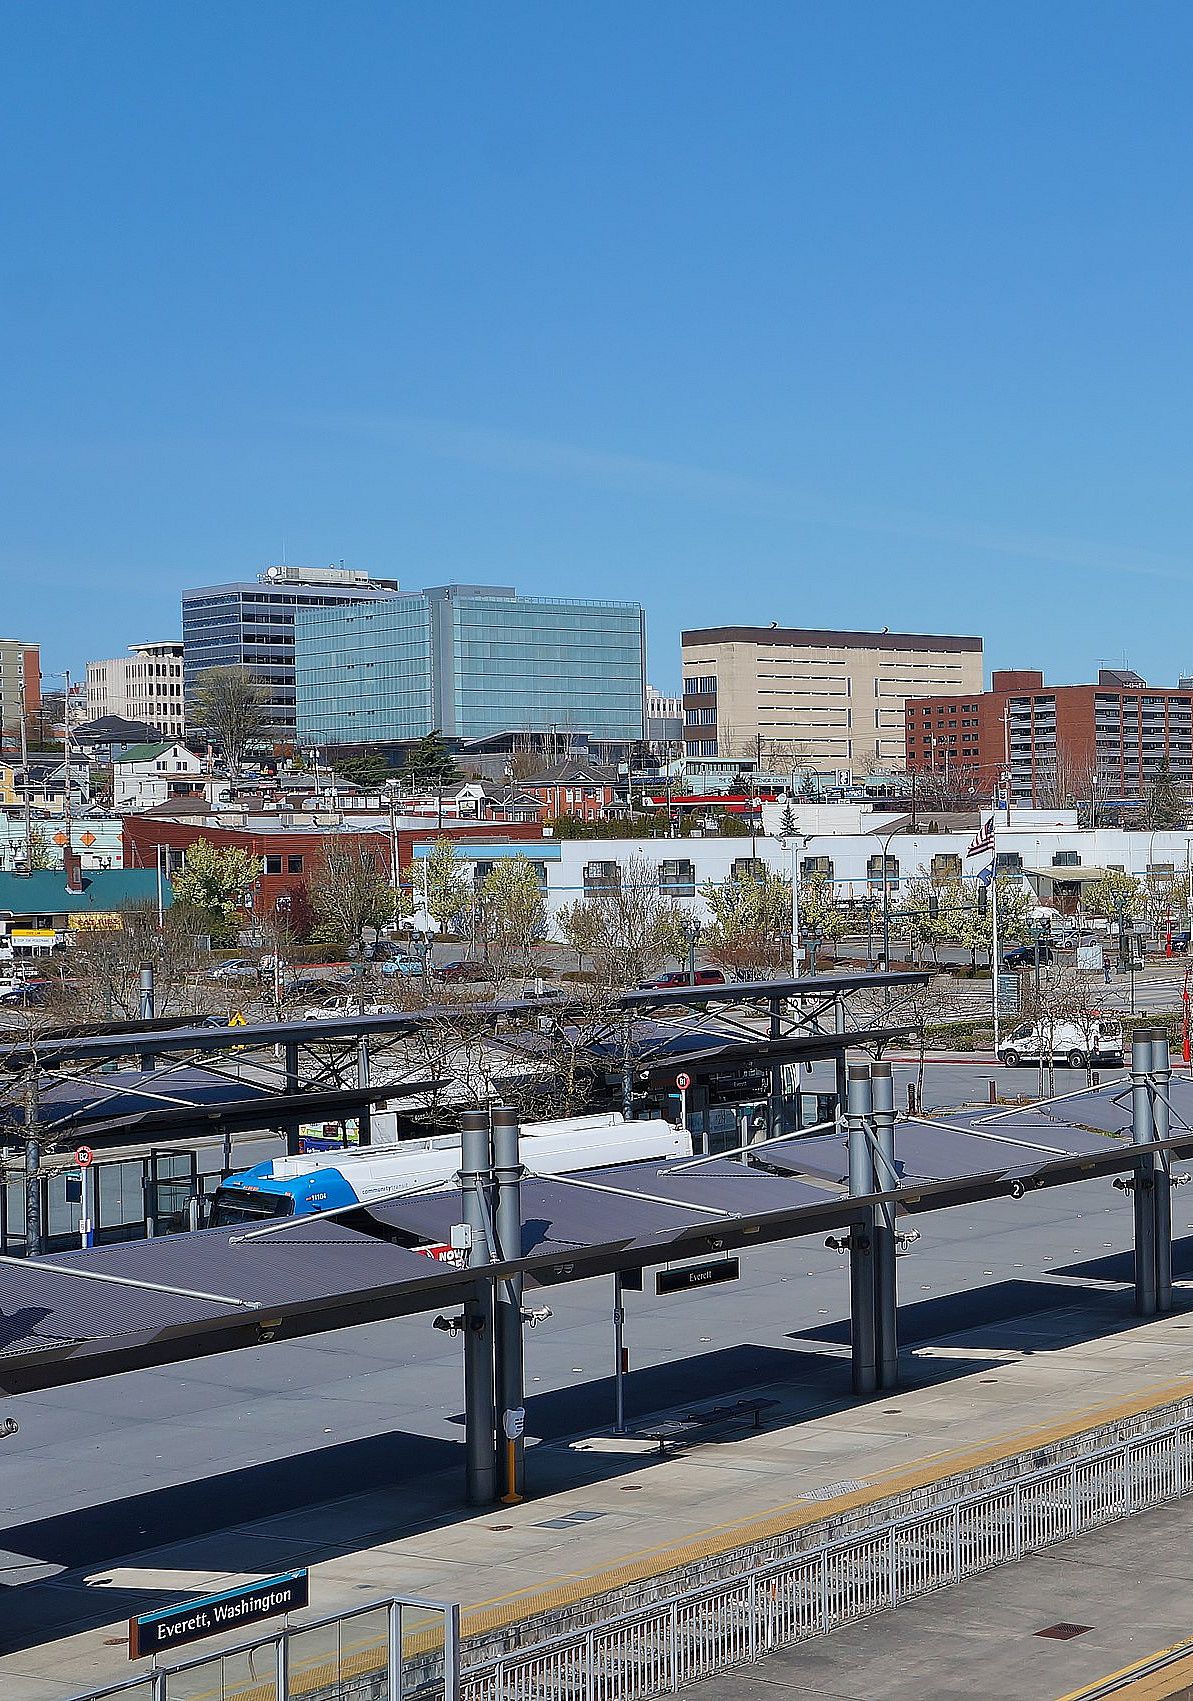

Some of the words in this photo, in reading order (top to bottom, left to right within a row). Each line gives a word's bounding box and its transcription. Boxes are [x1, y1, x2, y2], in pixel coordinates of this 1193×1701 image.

[79, 1152, 89, 1162] B2
[689, 1270, 712, 1282] Everett
[157, 1612, 211, 1640] Everett,
[213, 1589, 292, 1623] Washington
